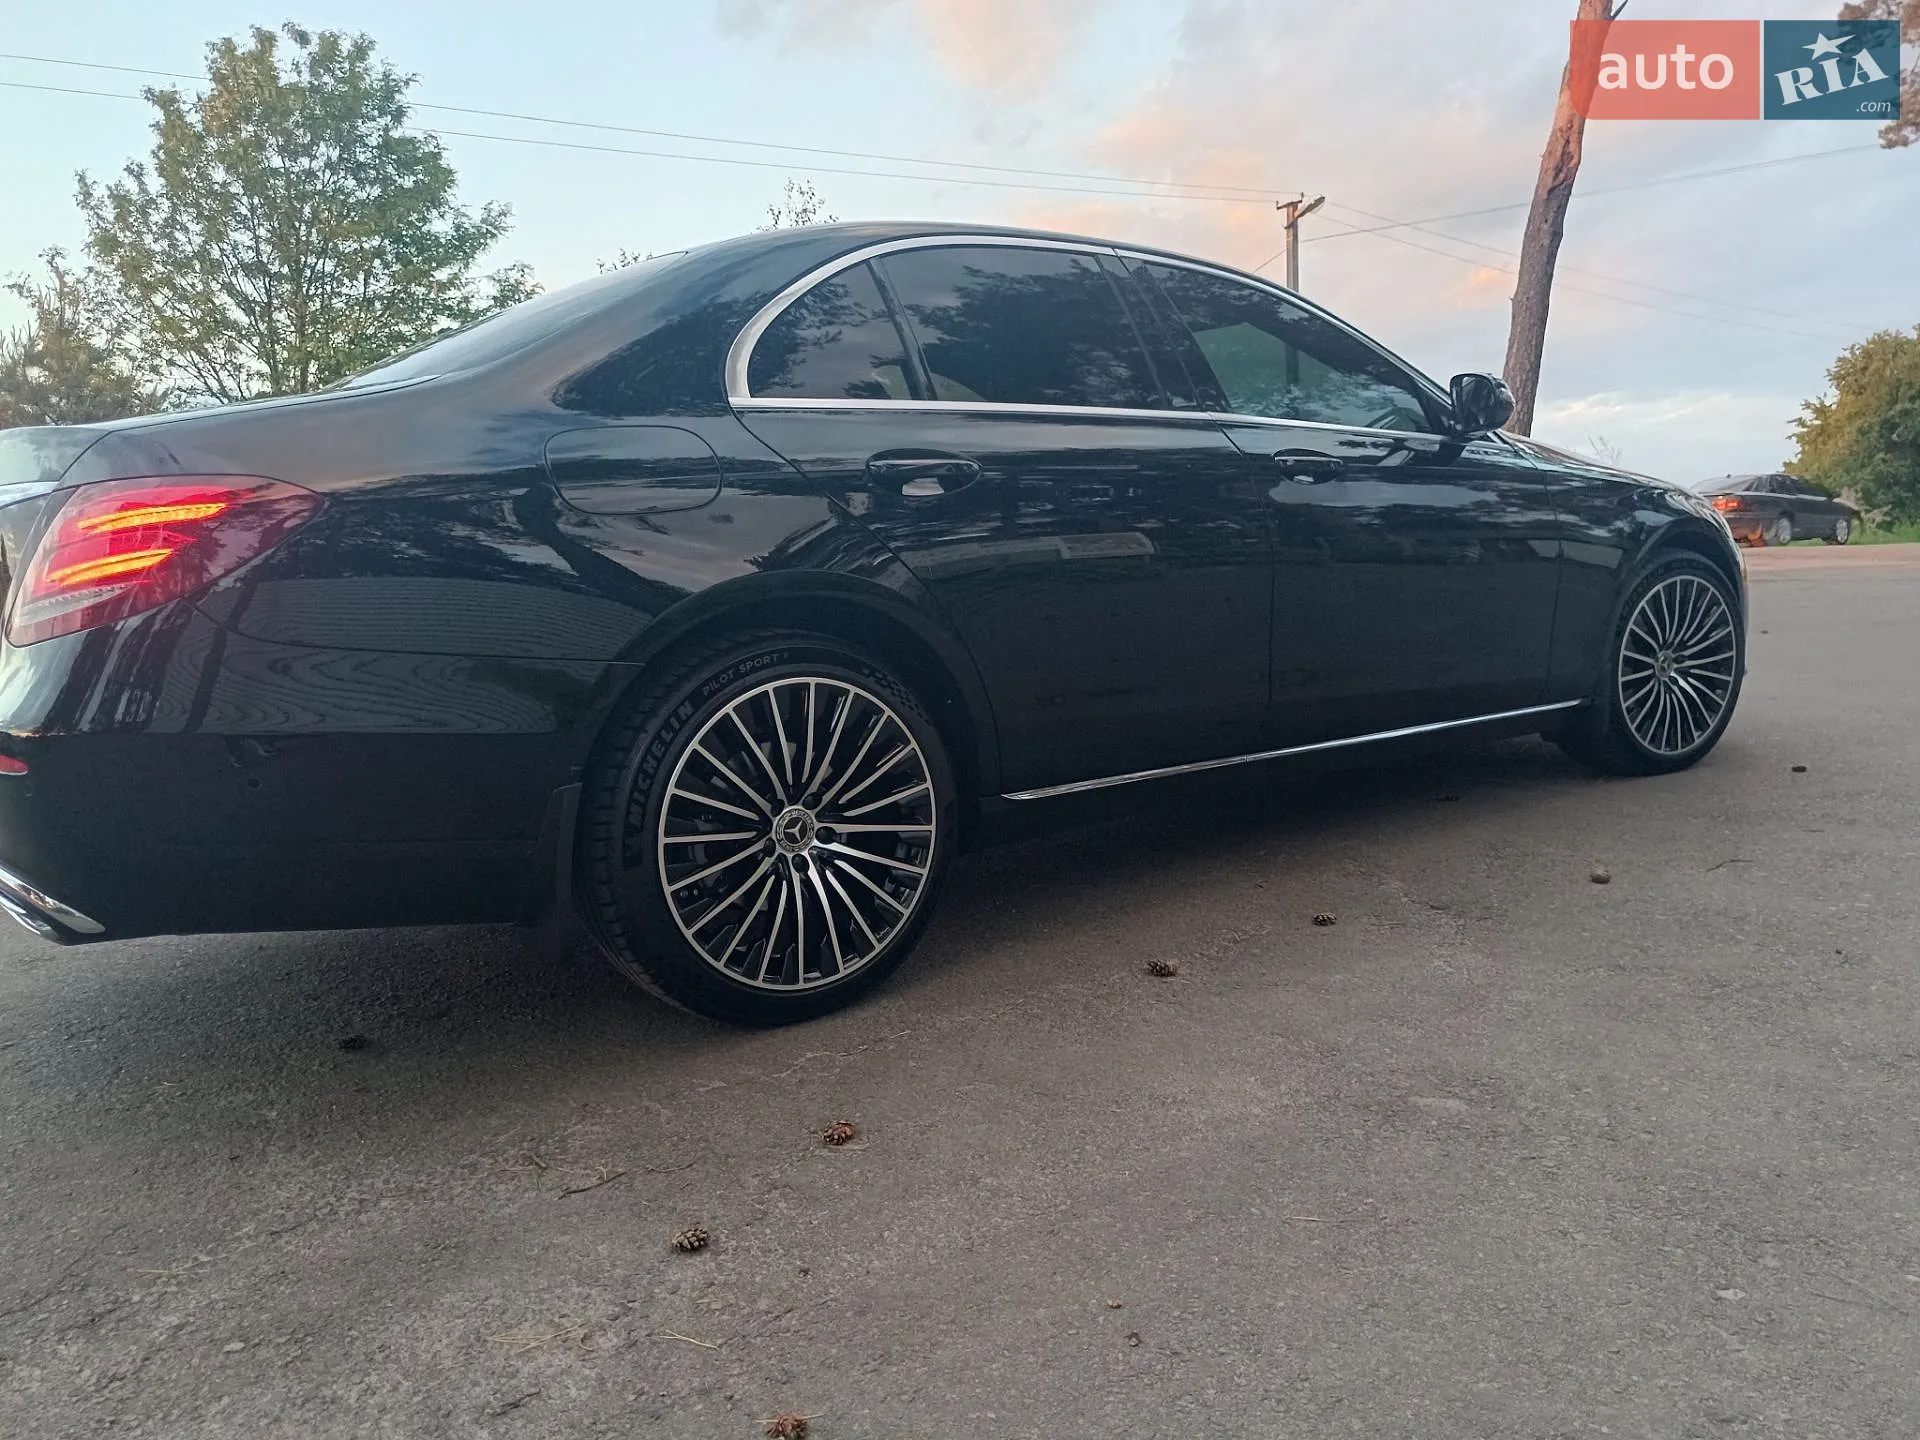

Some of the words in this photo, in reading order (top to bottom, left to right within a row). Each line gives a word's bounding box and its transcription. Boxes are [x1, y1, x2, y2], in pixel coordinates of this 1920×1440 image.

[702, 668, 735, 697] PILOT
[738, 653, 780, 673] SPORT
[628, 700, 695, 829] MICHELIN
